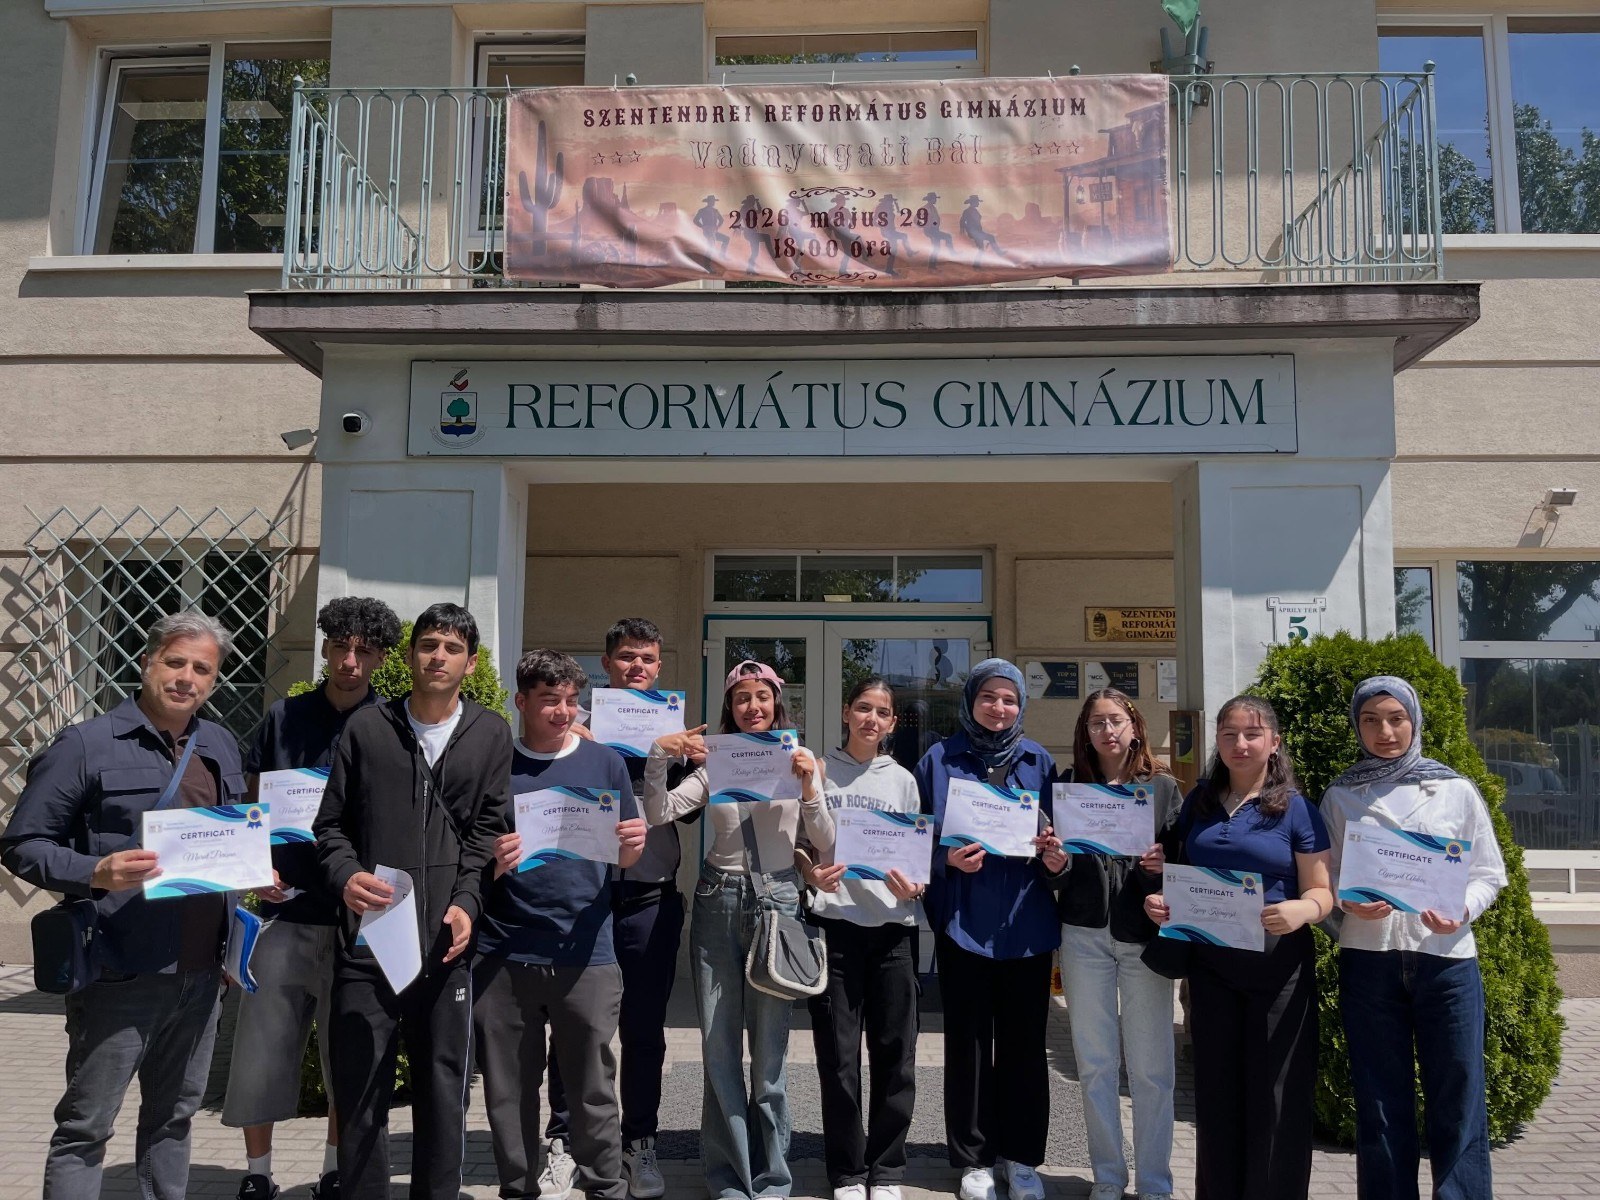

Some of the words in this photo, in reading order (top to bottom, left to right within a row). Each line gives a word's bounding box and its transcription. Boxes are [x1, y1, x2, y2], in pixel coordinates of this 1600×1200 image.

[583, 104, 751, 127] SZENTENDREI
[764, 98, 927, 123] REFORMÁTUS
[940, 95, 1087, 119] GIMNÁZIUM
[689, 136, 910, 173] Vadnyugati
[924, 133, 983, 166] Bál
[729, 207, 799, 230] 2026.
[810, 206, 889, 232] május
[900, 207, 938, 228] 29.
[773, 238, 839, 259] 18.00
[850, 235, 892, 258] óra
[505, 370, 907, 430] REFORMÁTUS
[933, 367, 1268, 429] GIMNÁZIUM
[1287, 615, 1308, 641] 5
[617, 707, 659, 715] CERTIFICATE
[731, 750, 773, 758] CERTIFICATE
[543, 806, 590, 816] CERTIFICATE
[971, 800, 1011, 812] CERTIFICATE
[1080, 802, 1125, 810] CERTIFICATE
[180, 828, 236, 840] CERTIFICATE
[862, 829, 906, 838] CERTIFICATE
[1377, 848, 1433, 864] CERTIFICATE
[1189, 886, 1235, 898] CERTIFICATE
